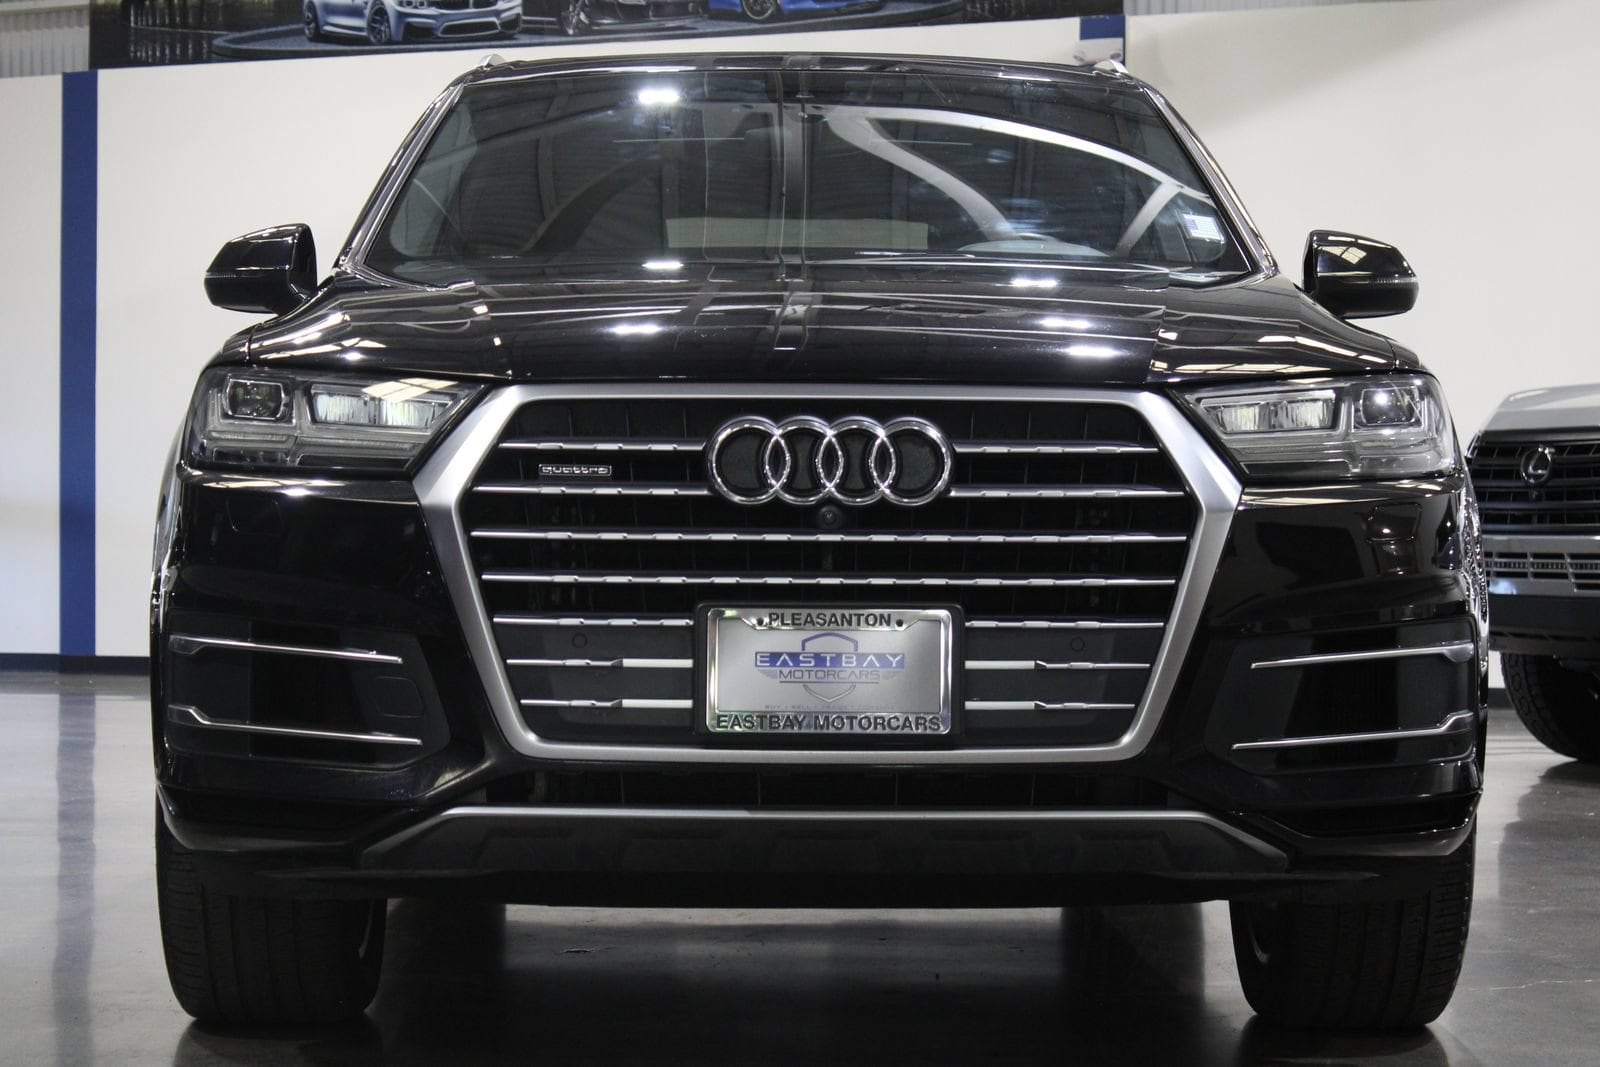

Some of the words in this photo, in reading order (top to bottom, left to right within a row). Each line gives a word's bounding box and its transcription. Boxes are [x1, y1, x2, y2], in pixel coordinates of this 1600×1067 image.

[768, 612, 892, 627] PLEASANTON
[756, 653, 904, 667] EASTBAY
[778, 669, 880, 680] MOTORCARS
[716, 713, 806, 730] EASTBAY
[813, 714, 942, 732] MOTORCARS
